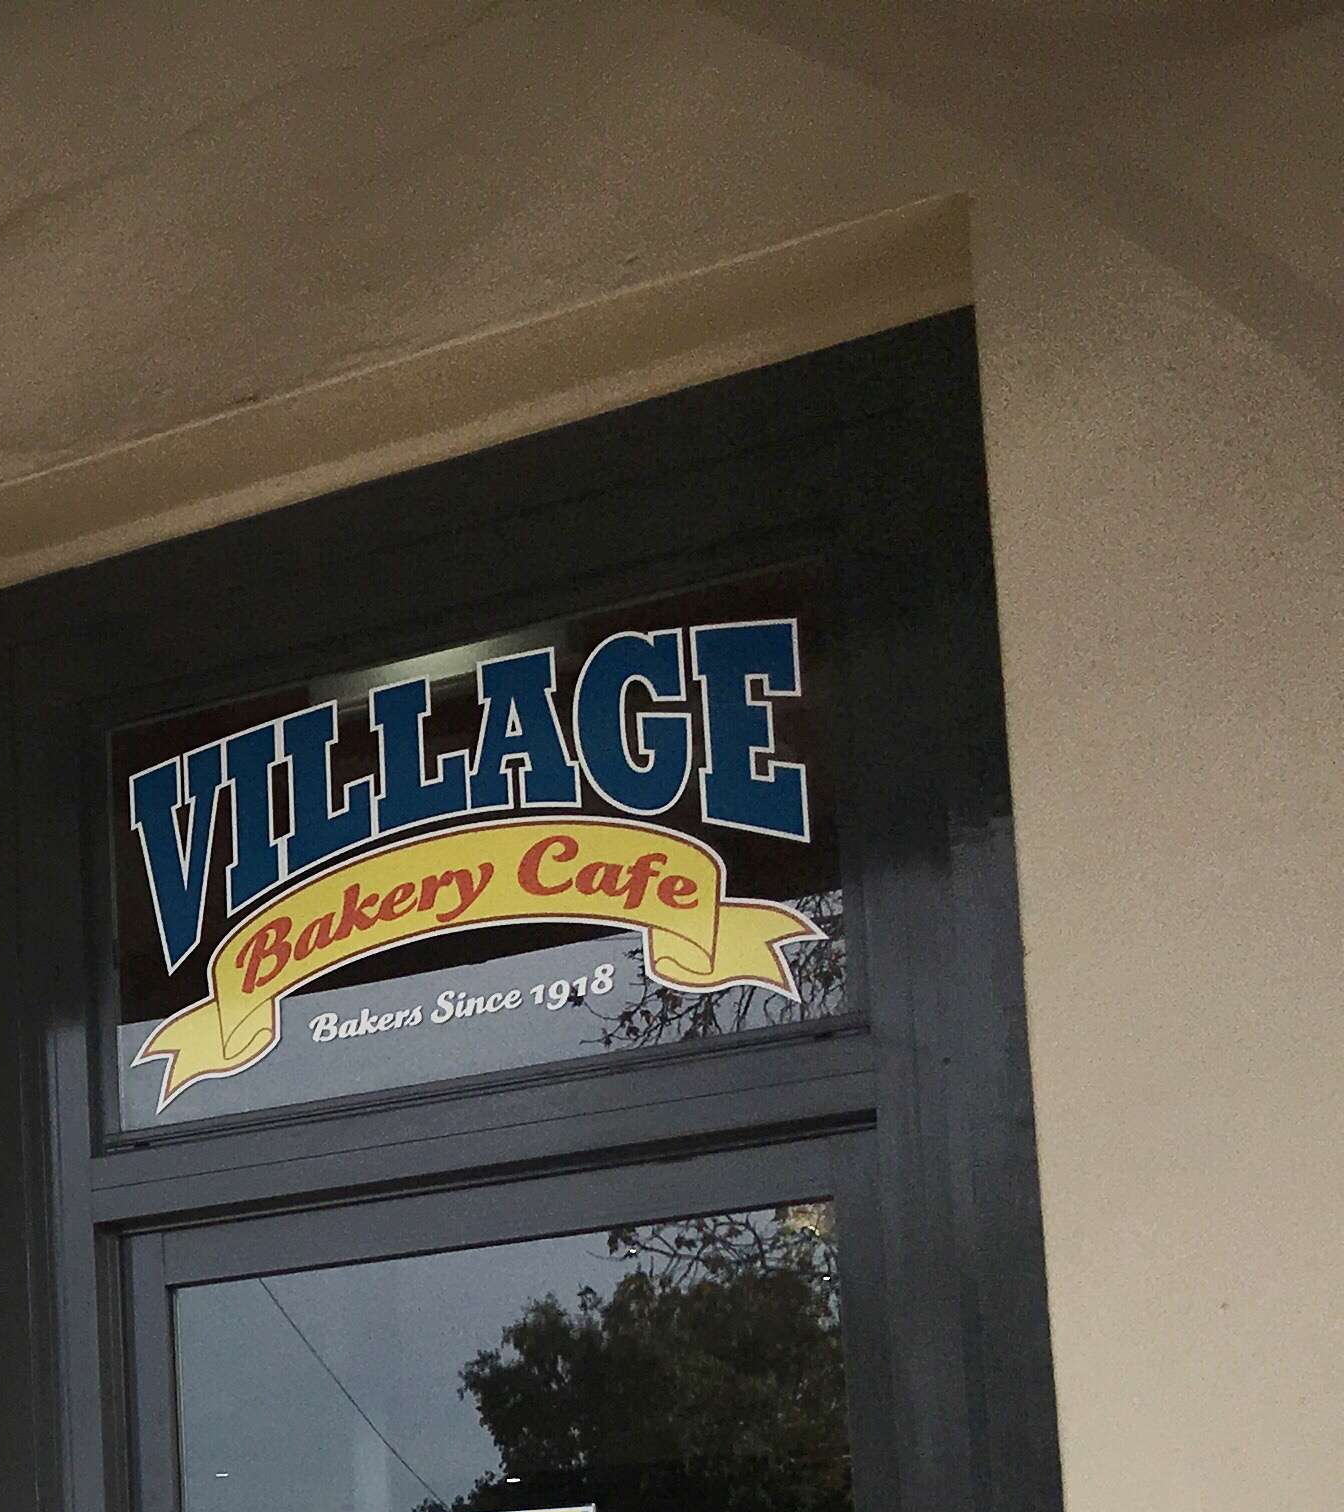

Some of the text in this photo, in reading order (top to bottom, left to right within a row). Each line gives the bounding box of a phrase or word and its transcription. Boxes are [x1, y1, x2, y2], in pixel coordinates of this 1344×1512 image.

[130, 617, 811, 976] VILLAGE
[233, 835, 700, 994] Bakery Cafe
[308, 962, 617, 1046] Bakers Since 1918
